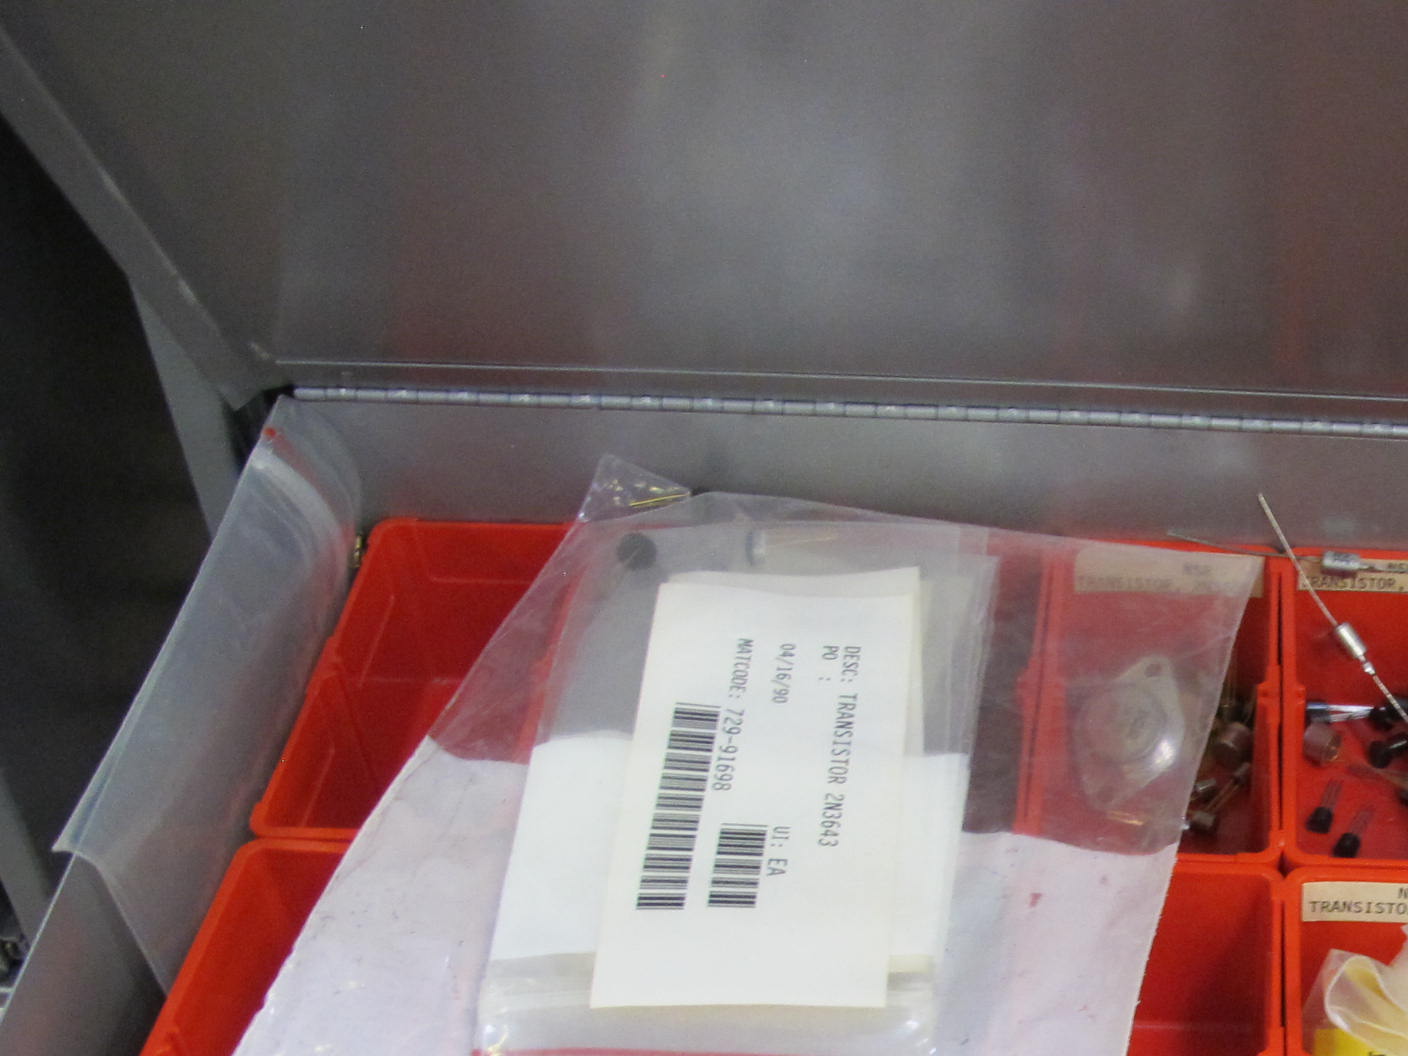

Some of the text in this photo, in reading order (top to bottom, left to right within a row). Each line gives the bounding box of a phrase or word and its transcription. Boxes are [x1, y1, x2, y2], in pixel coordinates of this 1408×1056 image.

[711, 708, 745, 791] 729-91698
[766, 643, 796, 877] 04/16/90 UI: EA
[817, 646, 862, 848] DESC: TRANSISTOR 2N3643
